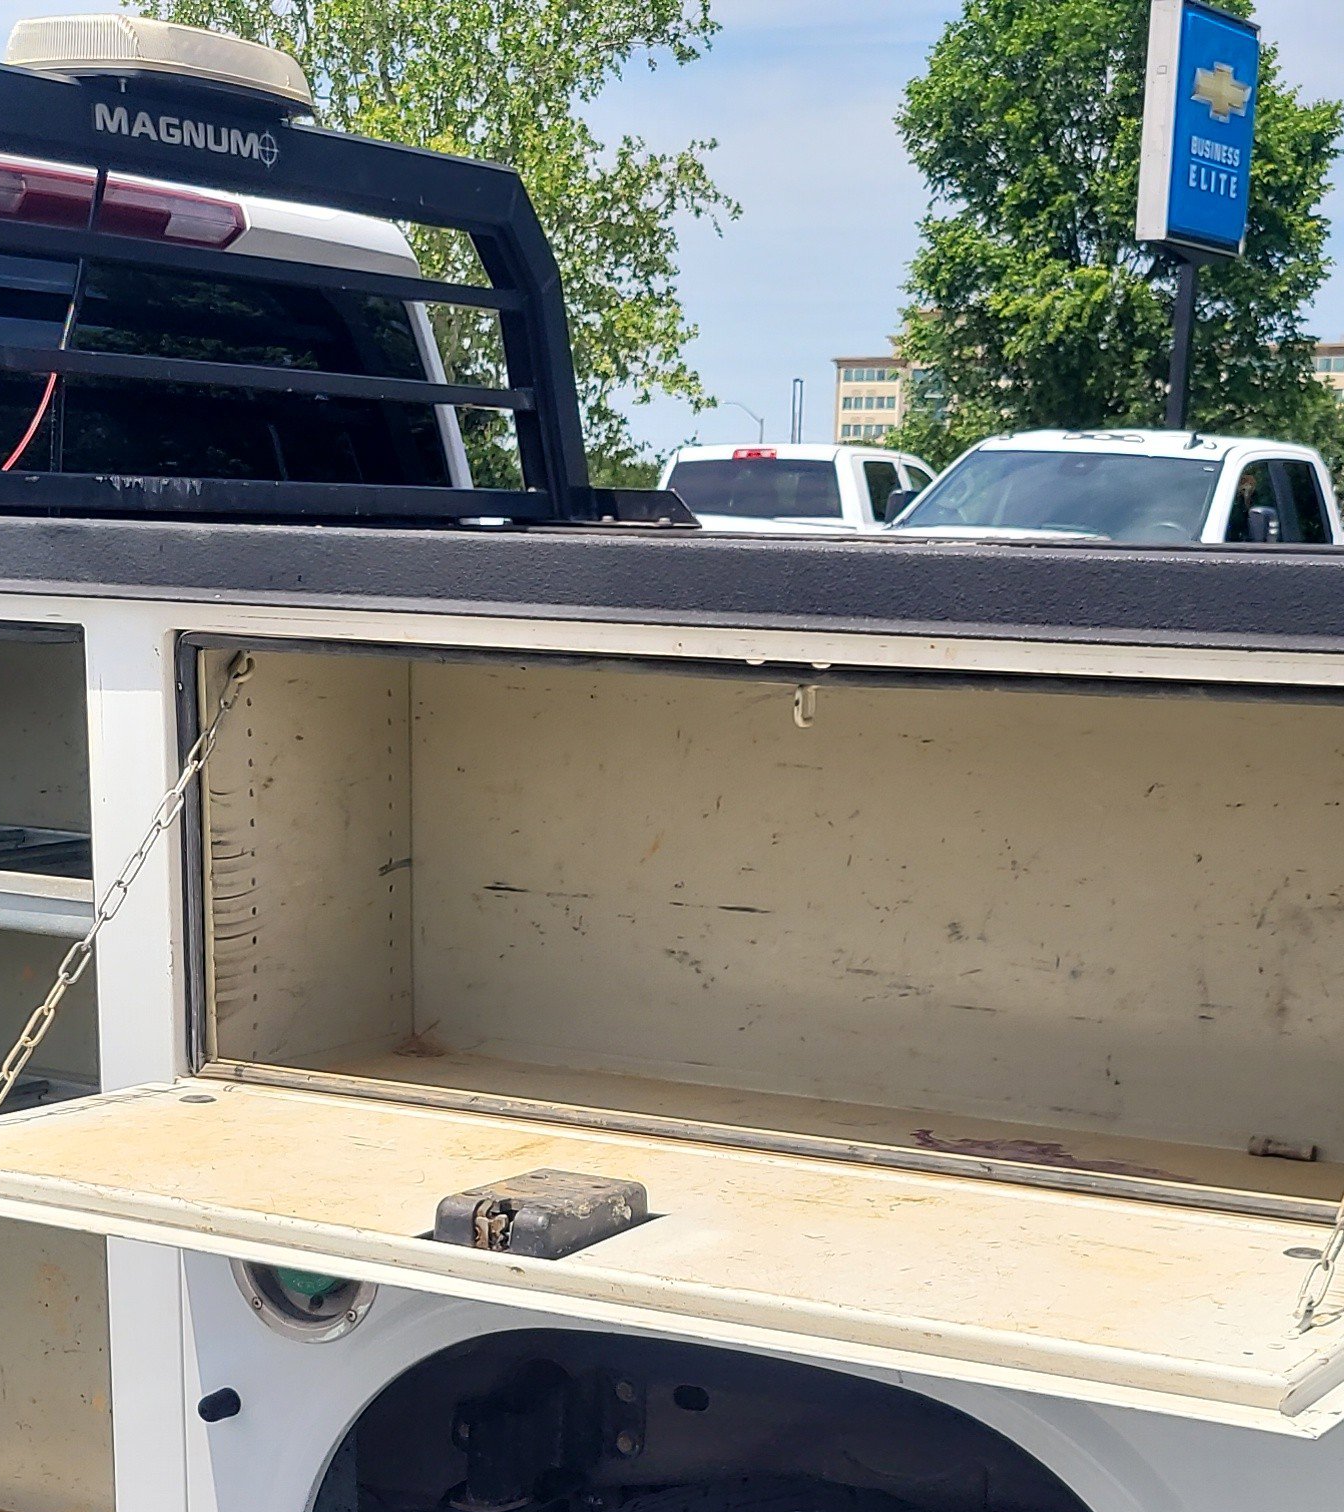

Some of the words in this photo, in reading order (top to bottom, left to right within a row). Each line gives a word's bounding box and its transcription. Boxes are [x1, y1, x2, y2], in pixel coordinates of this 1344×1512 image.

[94, 103, 260, 160] MAGNUM
[1190, 135, 1240, 167] BUSINESS
[1189, 164, 1238, 199] ELITE
